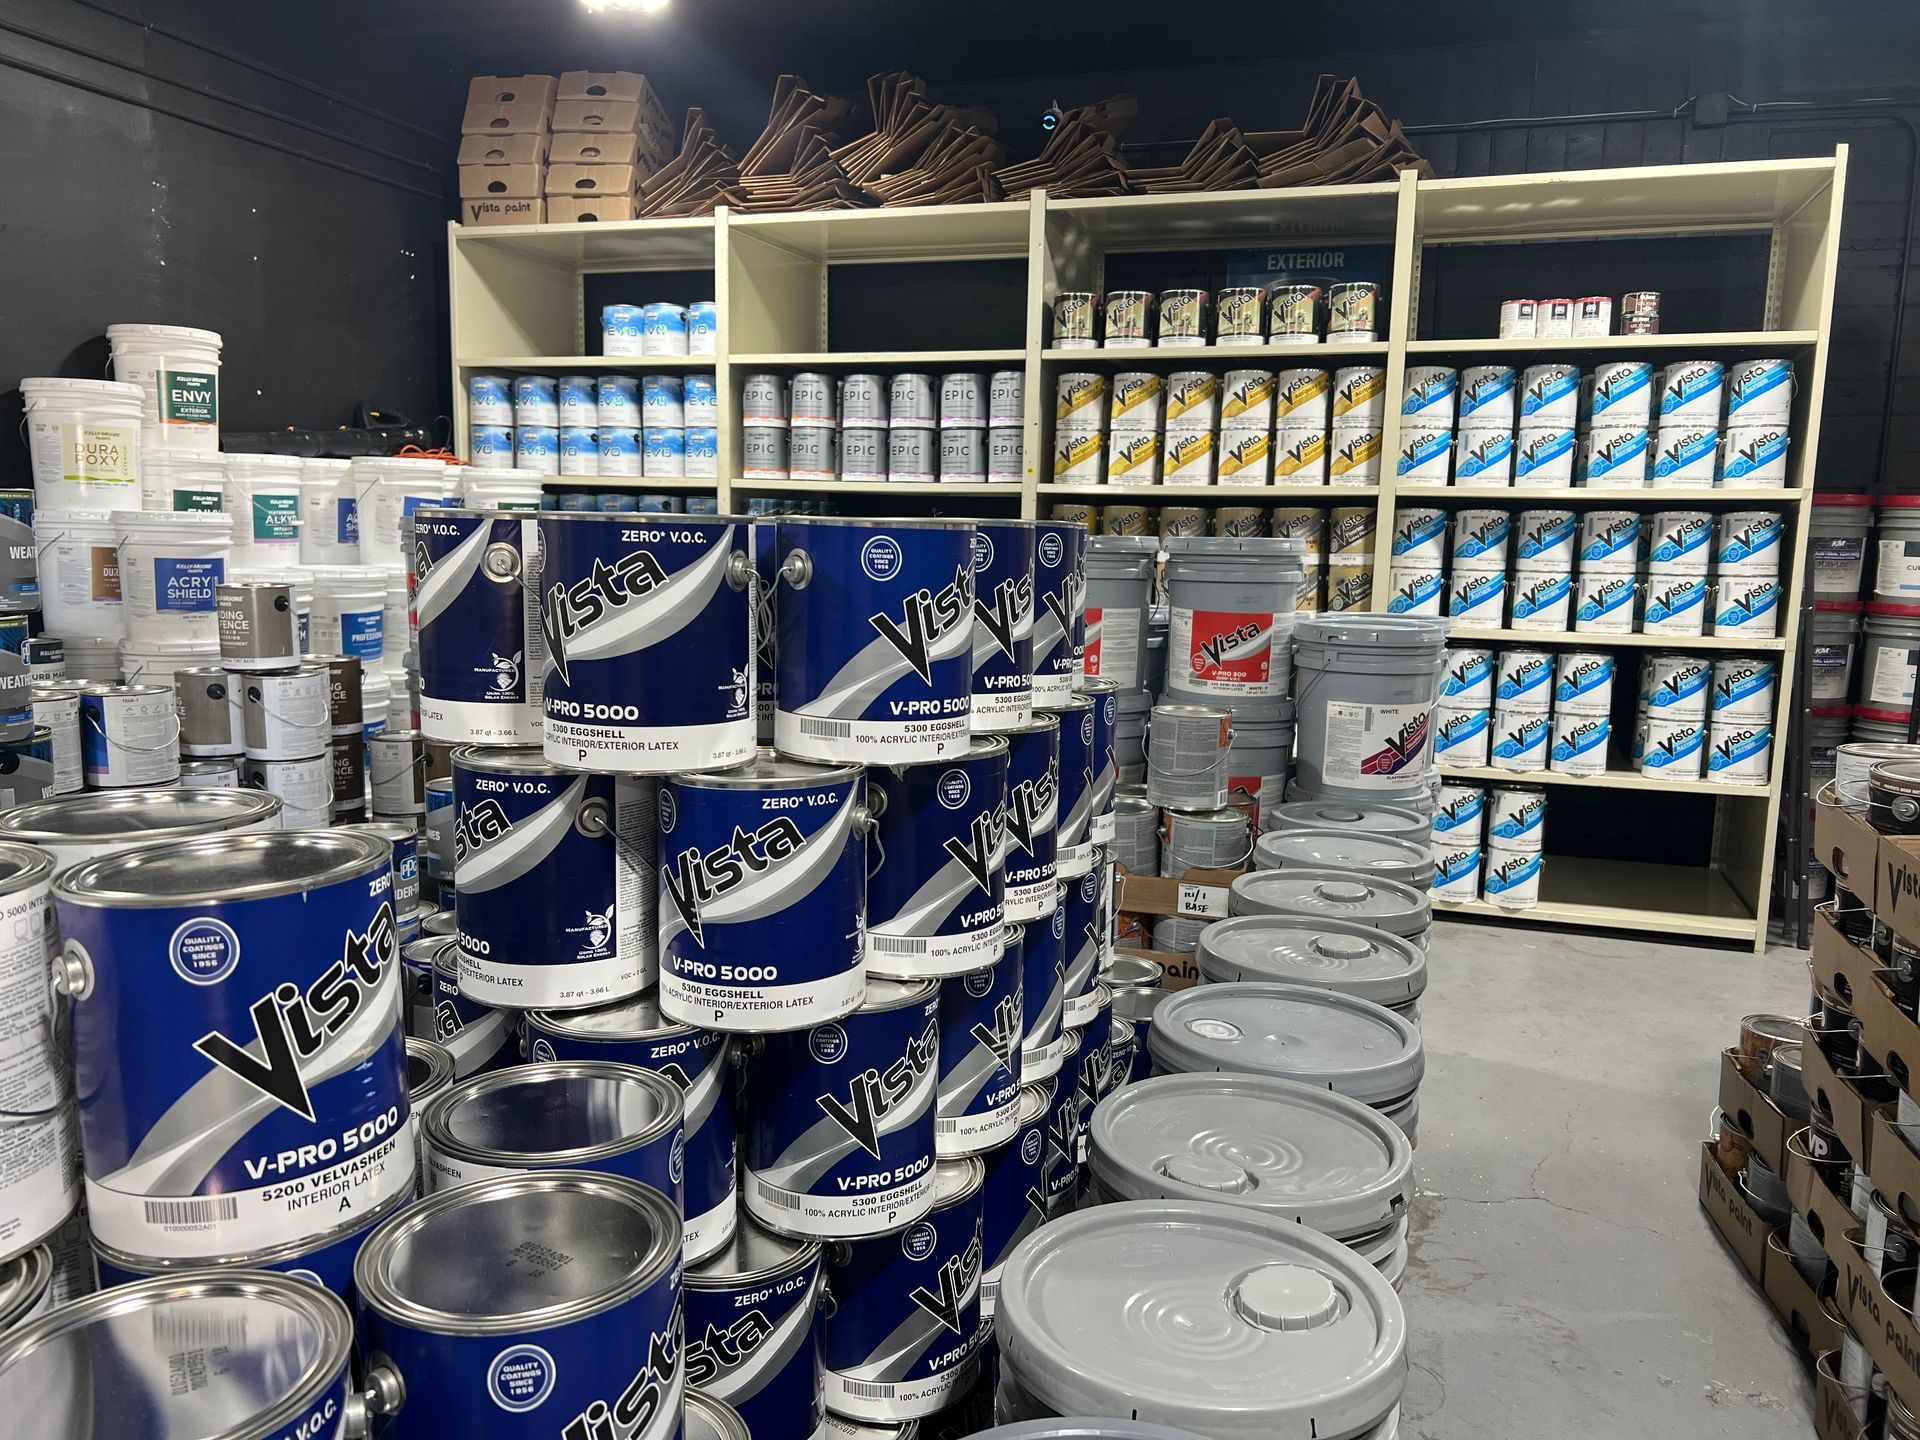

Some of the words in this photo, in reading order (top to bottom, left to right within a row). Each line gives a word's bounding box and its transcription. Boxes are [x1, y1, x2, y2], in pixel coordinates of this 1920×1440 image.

[471, 202, 501, 222] Vista
[505, 202, 531, 215] paint
[1267, 252, 1345, 270] EXTERIOR
[1057, 298, 1087, 329] Vista
[1162, 295, 1192, 327] Vista
[1221, 294, 1253, 325] Vista
[1274, 291, 1306, 324] Vista
[1335, 289, 1369, 321] Vista
[993, 389, 1020, 399] EPIC
[1116, 379, 1145, 407] Vista
[1281, 375, 1312, 406] Vista
[1341, 373, 1373, 404] Vista
[1412, 372, 1447, 403] Vista
[1465, 372, 1499, 404] Vista
[1529, 371, 1564, 403] Vista
[1597, 367, 1634, 401] Vista
[1668, 367, 1708, 401] Vista
[1732, 366, 1767, 401] Vista
[172, 390, 211, 403] ENVY
[795, 391, 823, 400] EPIC
[845, 391, 870, 400] EPIC
[75, 443, 119, 455] DURA
[747, 444, 775, 453] EPIC
[847, 446, 876, 455] EPIC
[892, 446, 919, 455] EPIC
[994, 446, 1023, 455] EPIC
[1059, 436, 1088, 464] Vista
[1169, 436, 1198, 464] Vista
[1287, 435, 1319, 463] Vista
[1522, 433, 1557, 465] Vista
[1597, 432, 1635, 465] Vista
[1739, 431, 1780, 465] Vista
[433, 524, 460, 536] V.O.C.
[670, 531, 707, 544] V.O.C.
[1334, 514, 1365, 545] Vista
[1528, 517, 1564, 548] Vista
[1666, 518, 1705, 551] Vista
[1733, 519, 1774, 551] Vista
[167, 577, 210, 588] ACRY
[1337, 572, 1370, 603] Vista
[167, 589, 212, 599] SHIELD
[1656, 582, 1694, 612] Vista
[1733, 583, 1774, 616] Vista
[540, 550, 670, 687] Vista
[1200, 623, 1260, 670] Vista
[1507, 660, 1543, 689] Vista
[1662, 666, 1701, 697] Vista
[1717, 669, 1755, 700] Vista
[545, 697, 581, 718] V-PRO
[583, 704, 639, 721] 5000
[890, 700, 941, 716] V-PRO
[943, 696, 970, 714] 5000
[553, 723, 568, 735] 5300
[570, 726, 625, 739] EGGSHELL
[904, 723, 928, 733] 5300
[930, 720, 965, 732] EGGSHELL
[1384, 712, 1426, 760] Vista
[1562, 722, 1598, 751] Vista
[561, 735, 646, 750] INTERIOR/EXTERIOR
[648, 740, 679, 750] LATEX
[855, 734, 878, 744] 100%
[878, 732, 918, 743] ACRYLIC
[937, 743, 944, 754] P
[1716, 731, 1755, 761] Vista
[578, 750, 587, 762] P
[512, 782, 550, 794] V.O.C.
[807, 792, 838, 806] V.O.C.
[1442, 795, 1476, 823] Vista
[1005, 867, 1041, 883] V-PRO
[1494, 857, 1528, 885] Vista
[662, 816, 807, 949] Vista
[1014, 888, 1032, 896] 5300
[1186, 902, 1208, 912] BASE
[961, 910, 995, 928] V-PRO
[184, 935, 221, 945] QUALITY
[460, 936, 490, 955] 5000
[971, 931, 989, 942] 5300
[183, 943, 225, 953] COATINGS
[192, 952, 217, 960] SINCE
[931, 947, 951, 957] 100%
[952, 943, 981, 955] ACRYLIC
[193, 960, 218, 968] 1956
[671, 955, 717, 979] V-PRO
[720, 966, 777, 981] 5000
[497, 978, 523, 987] LATEX
[682, 983, 702, 995] 5300
[705, 988, 764, 1000] EGGSHELL
[193, 901, 397, 1123] Vista
[696, 996, 783, 1010] INTERIOR/EXTERIOR
[785, 995, 814, 1006] LATEX
[714, 1009, 724, 1022] P
[693, 1033, 720, 1049] V.O.C.
[816, 1018, 939, 1160] Vista
[244, 1138, 338, 1180] V-PRO
[343, 1105, 398, 1152] 5000
[262, 1181, 305, 1203] 5200
[311, 1139, 396, 1189] VELVASHEEN
[837, 1173, 893, 1191] V-PRO
[895, 1156, 929, 1181] 5000
[287, 1179, 351, 1212] INTERIOR
[354, 1161, 386, 1187] LATEX
[852, 1196, 877, 1208] 5300
[880, 1181, 923, 1205] EGGSHELL
[338, 1195, 351, 1212] A
[804, 1208, 826, 1217] 100%
[828, 1205, 866, 1218] ACRYLIC
[888, 1211, 897, 1224] P
[776, 1277, 806, 1295] V.O.C.
[1846, 1262, 1882, 1326] Vista
[503, 1361, 539, 1372] QUALITY
[929, 1344, 969, 1371] V-PRO
[501, 1369, 542, 1380] COATINGS
[509, 1378, 534, 1387] SINCE
[510, 1386, 534, 1395] 1956
[899, 1392, 919, 1402] 100%
[920, 1384, 950, 1399] ACRYLIC
